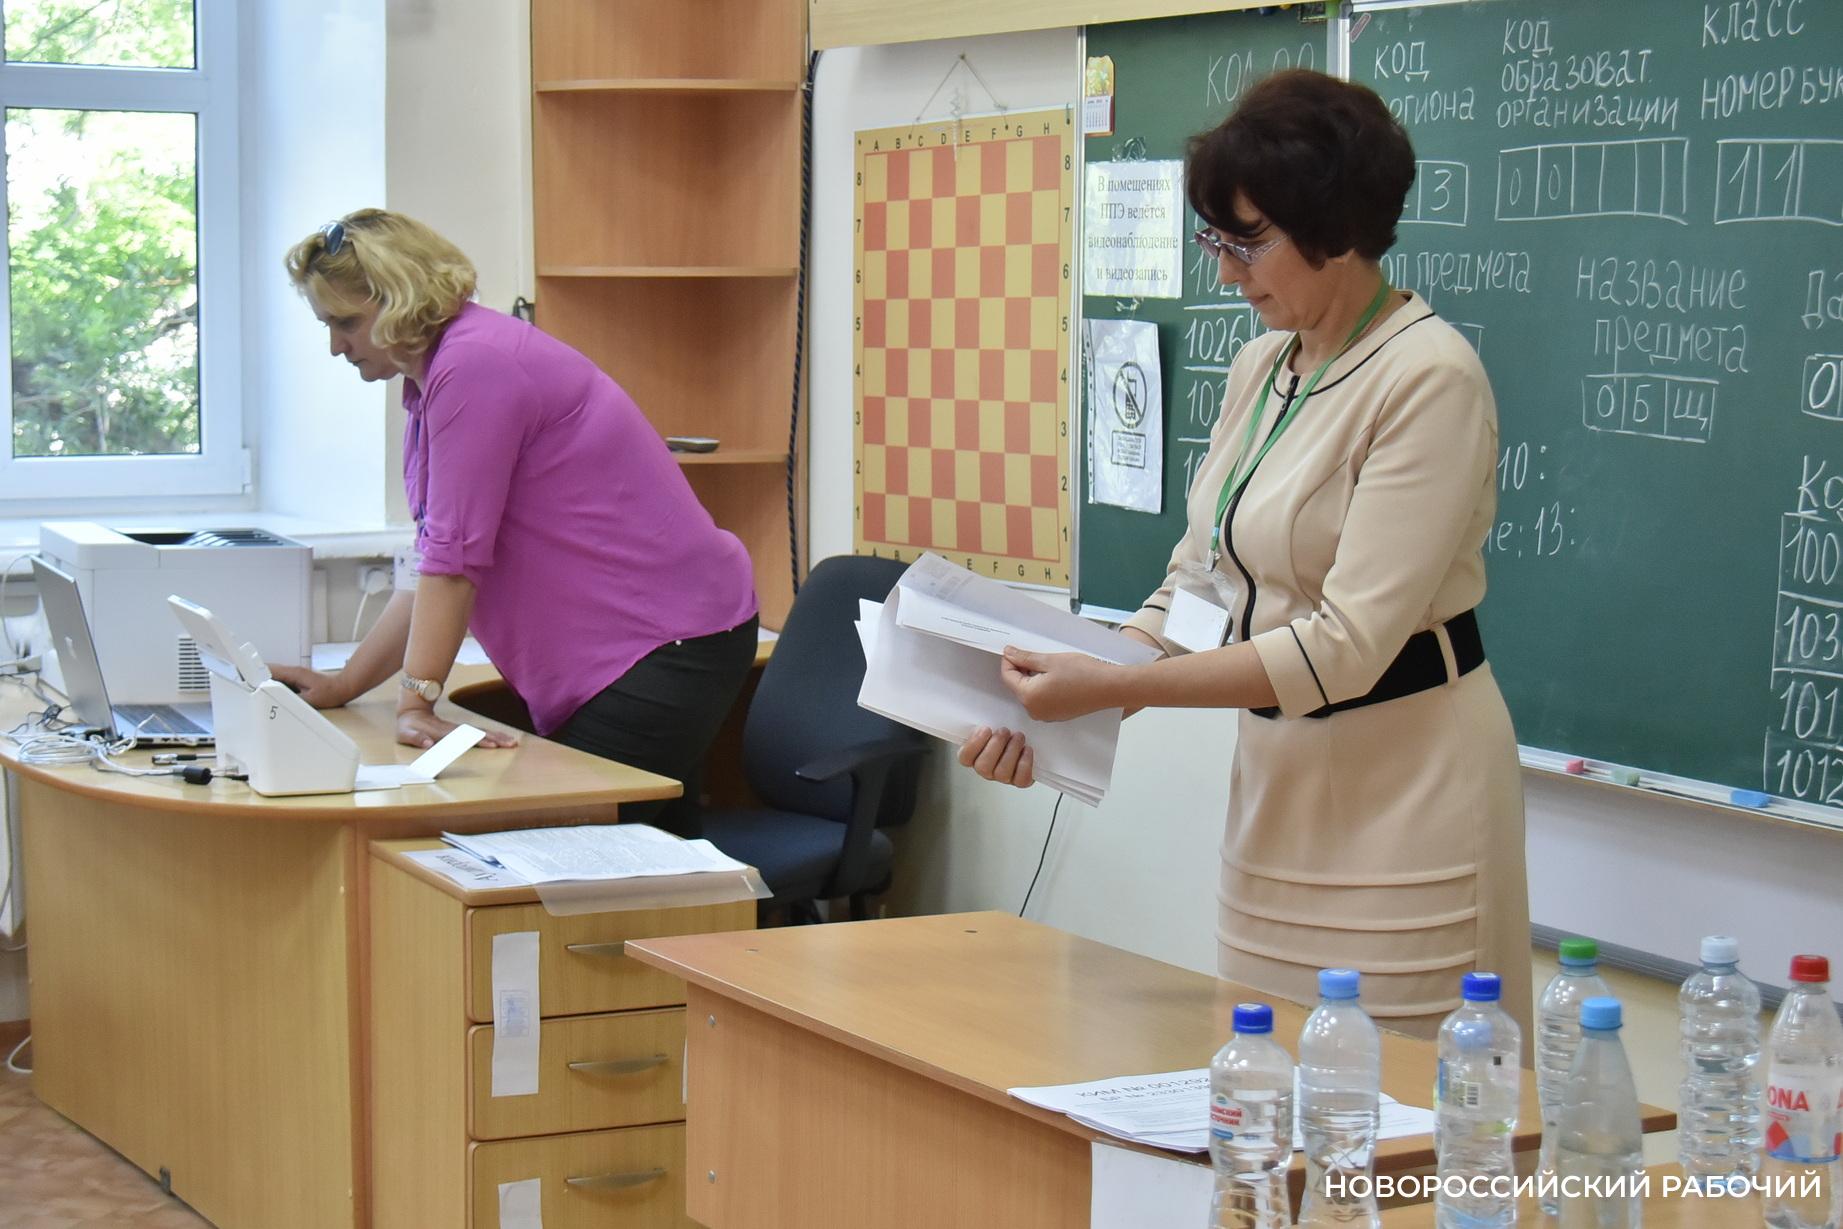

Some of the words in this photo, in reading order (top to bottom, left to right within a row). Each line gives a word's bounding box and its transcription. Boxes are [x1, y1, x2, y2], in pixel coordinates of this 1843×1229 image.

[1065, 155, 1071, 170] 8
[1098, 175, 1105, 192] В
[1108, 178, 1170, 193] помещениях
[1064, 207, 1070, 222] 7
[1101, 202, 1125, 219] ППЭ
[1088, 232, 1178, 249] видеонаблюдение
[1063, 264, 1069, 279] 6
[1096, 267, 1103, 280] и
[1106, 267, 1168, 281] видеозапись
[1576, 255, 1747, 313] название
[1062, 316, 1068, 332] 5
[1595, 318, 1749, 382] предмета
[1061, 368, 1067, 383] 4
[1061, 421, 1067, 437] 3
[1061, 476, 1067, 491] 2
[1062, 526, 1068, 542] 1
[993, 561, 998, 573] F
[1017, 564, 1025, 577] G
[1044, 567, 1051, 580] H
[269, 705, 278, 719] 5
